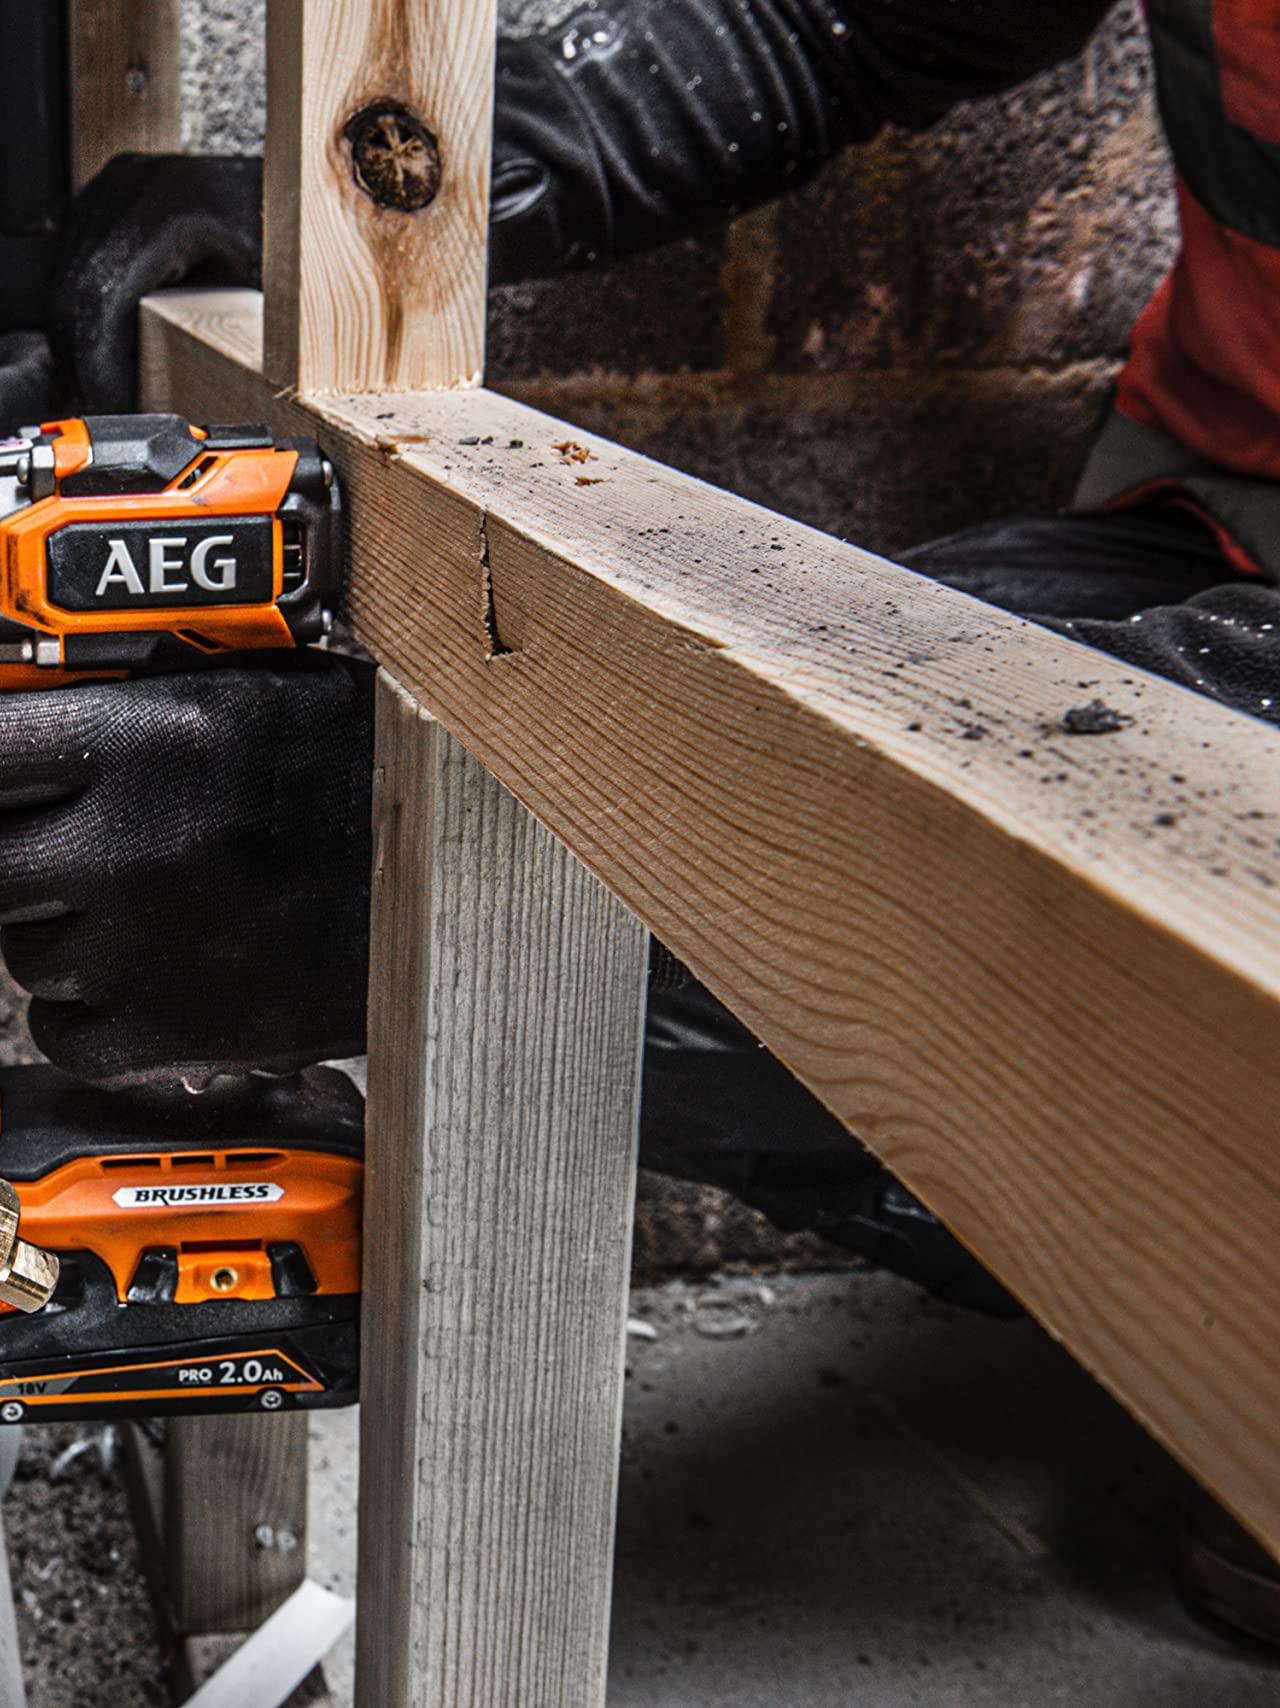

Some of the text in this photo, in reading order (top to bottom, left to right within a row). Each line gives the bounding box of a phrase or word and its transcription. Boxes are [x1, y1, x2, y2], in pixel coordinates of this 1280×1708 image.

[95, 535, 237, 596] AEG
[134, 1185, 269, 1206] BRUSHLESS
[179, 1360, 283, 1383] PRO 2.0Ah
[17, 1382, 47, 1395] 18V
